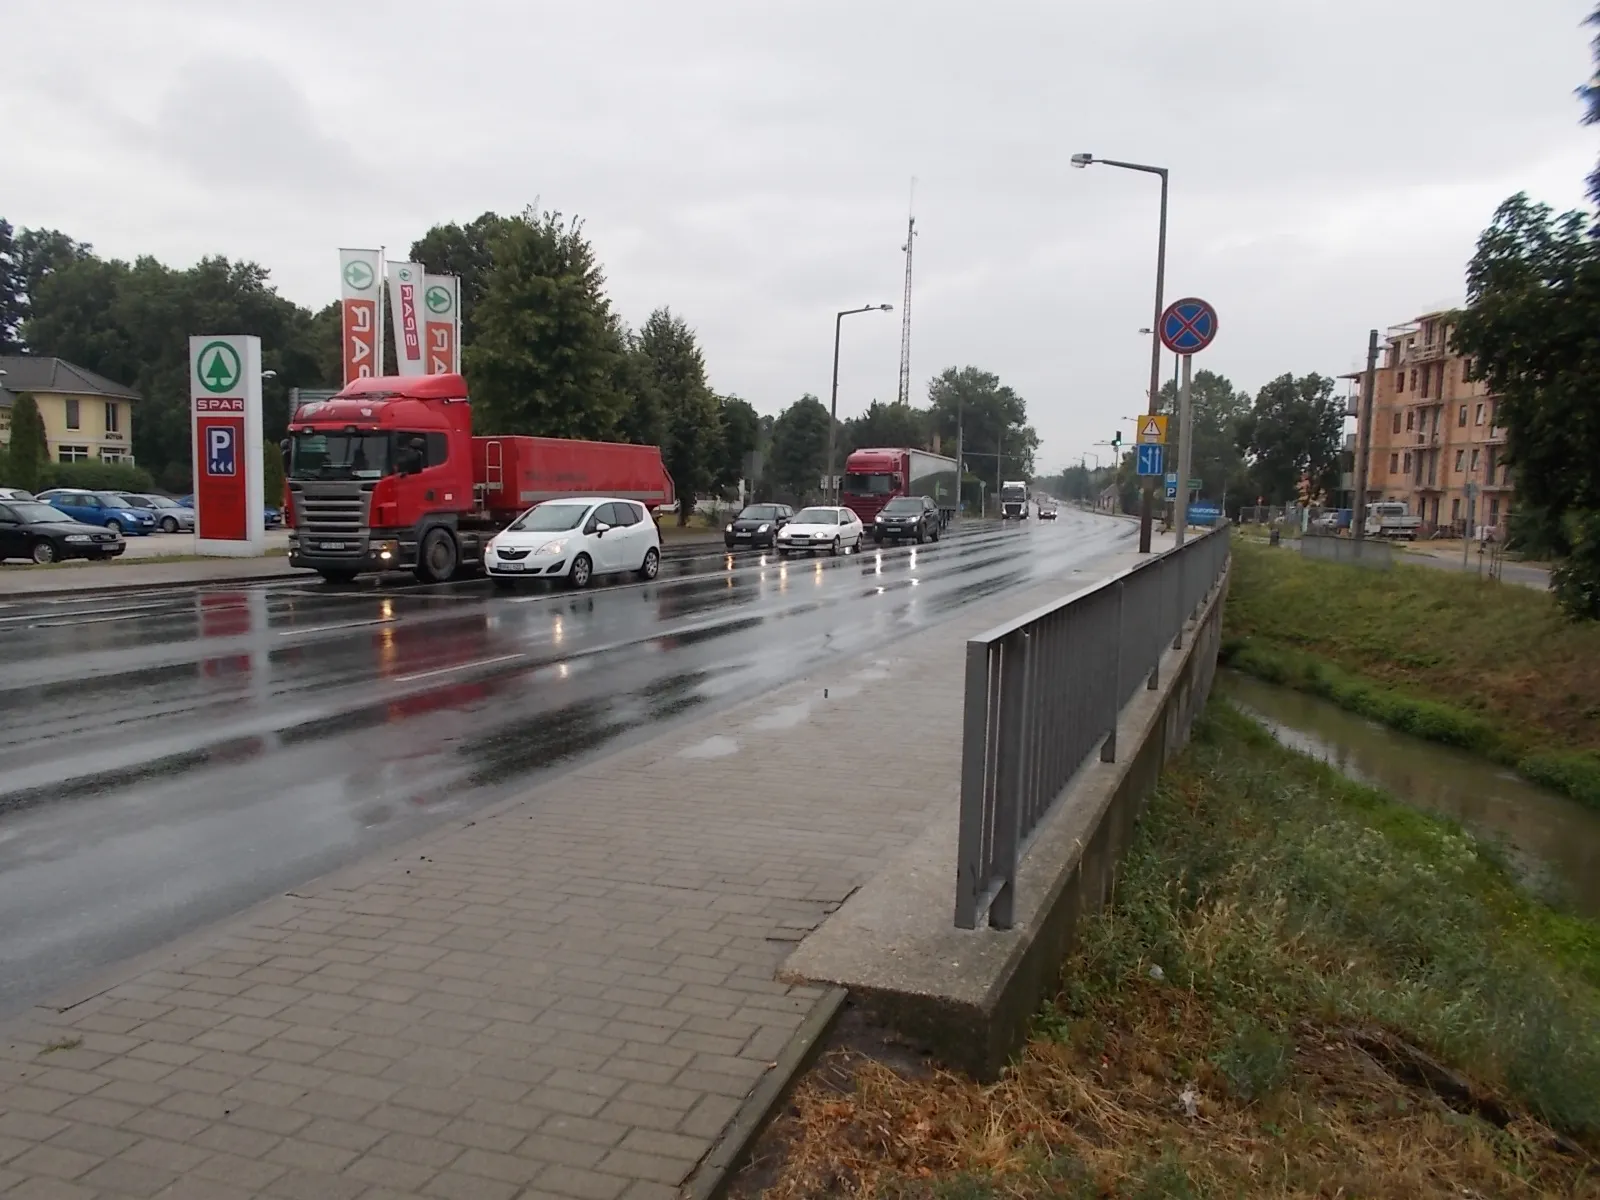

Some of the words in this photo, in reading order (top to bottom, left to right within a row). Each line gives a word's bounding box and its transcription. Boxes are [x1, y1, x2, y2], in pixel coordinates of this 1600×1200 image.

[197, 399, 244, 410] SPAR
[211, 430, 231, 459] P
[1167, 487, 1175, 497] P
